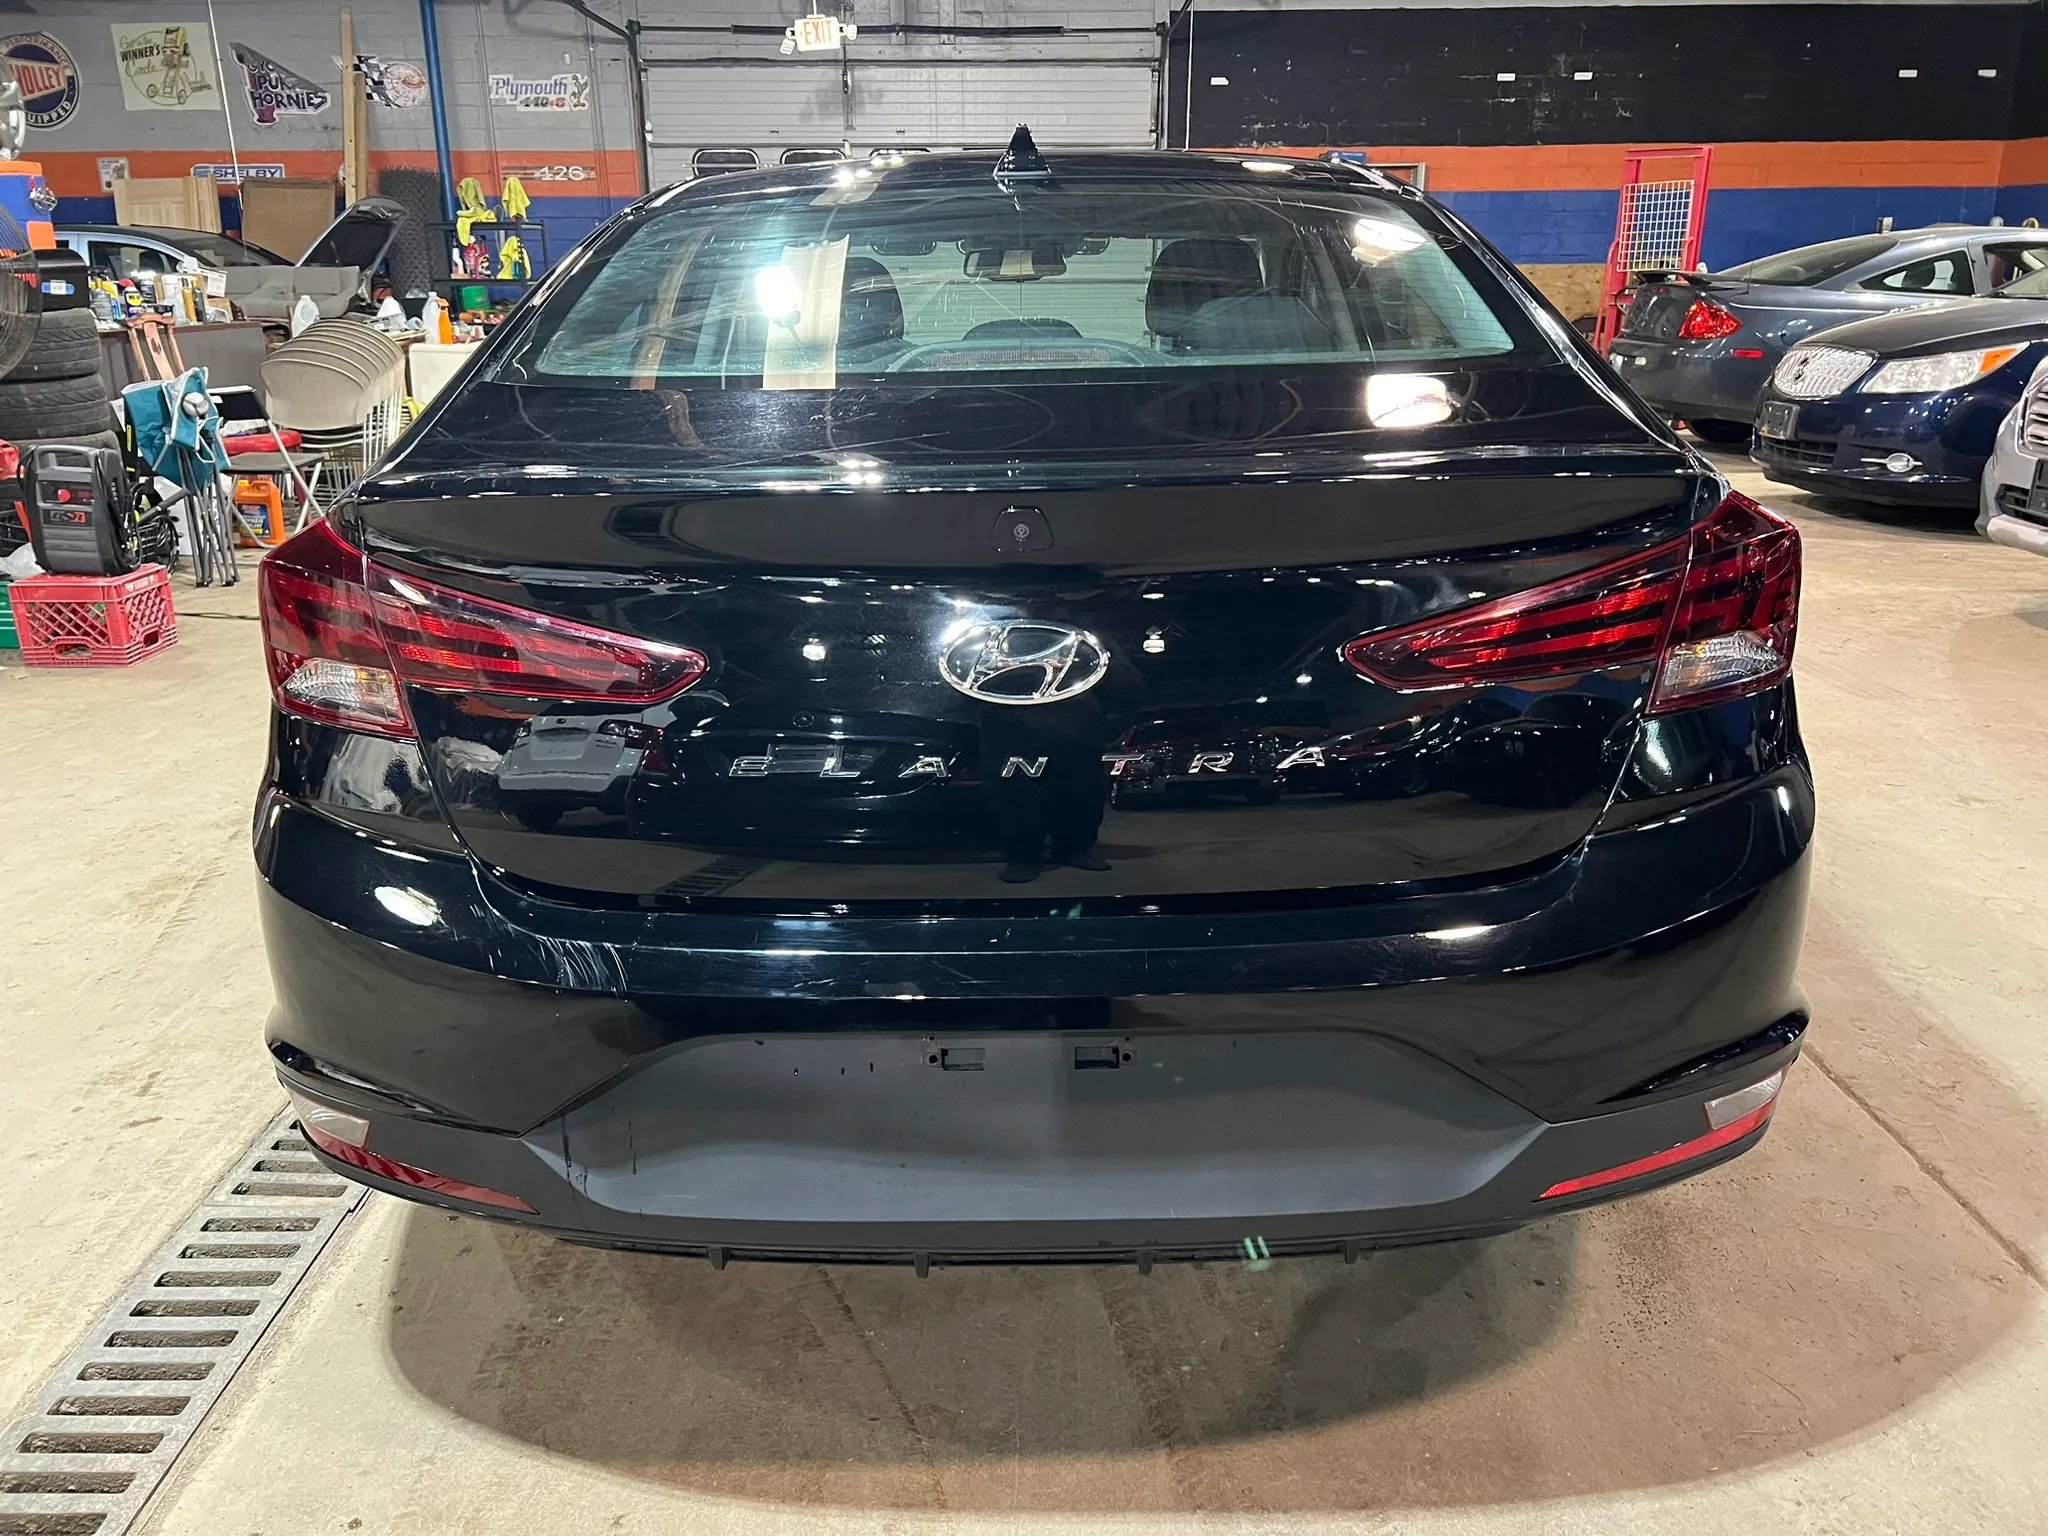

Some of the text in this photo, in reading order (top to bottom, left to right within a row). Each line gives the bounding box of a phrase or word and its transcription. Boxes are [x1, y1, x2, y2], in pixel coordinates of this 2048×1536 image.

[803, 20, 832, 45] EXIT
[120, 43, 160, 62] WINNER'S
[491, 78, 567, 101] Plymouth
[27, 100, 71, 124] UIPPED
[214, 167, 279, 178] SHELBY
[537, 165, 585, 181] 426
[729, 746, 1326, 778] ELANTRA
